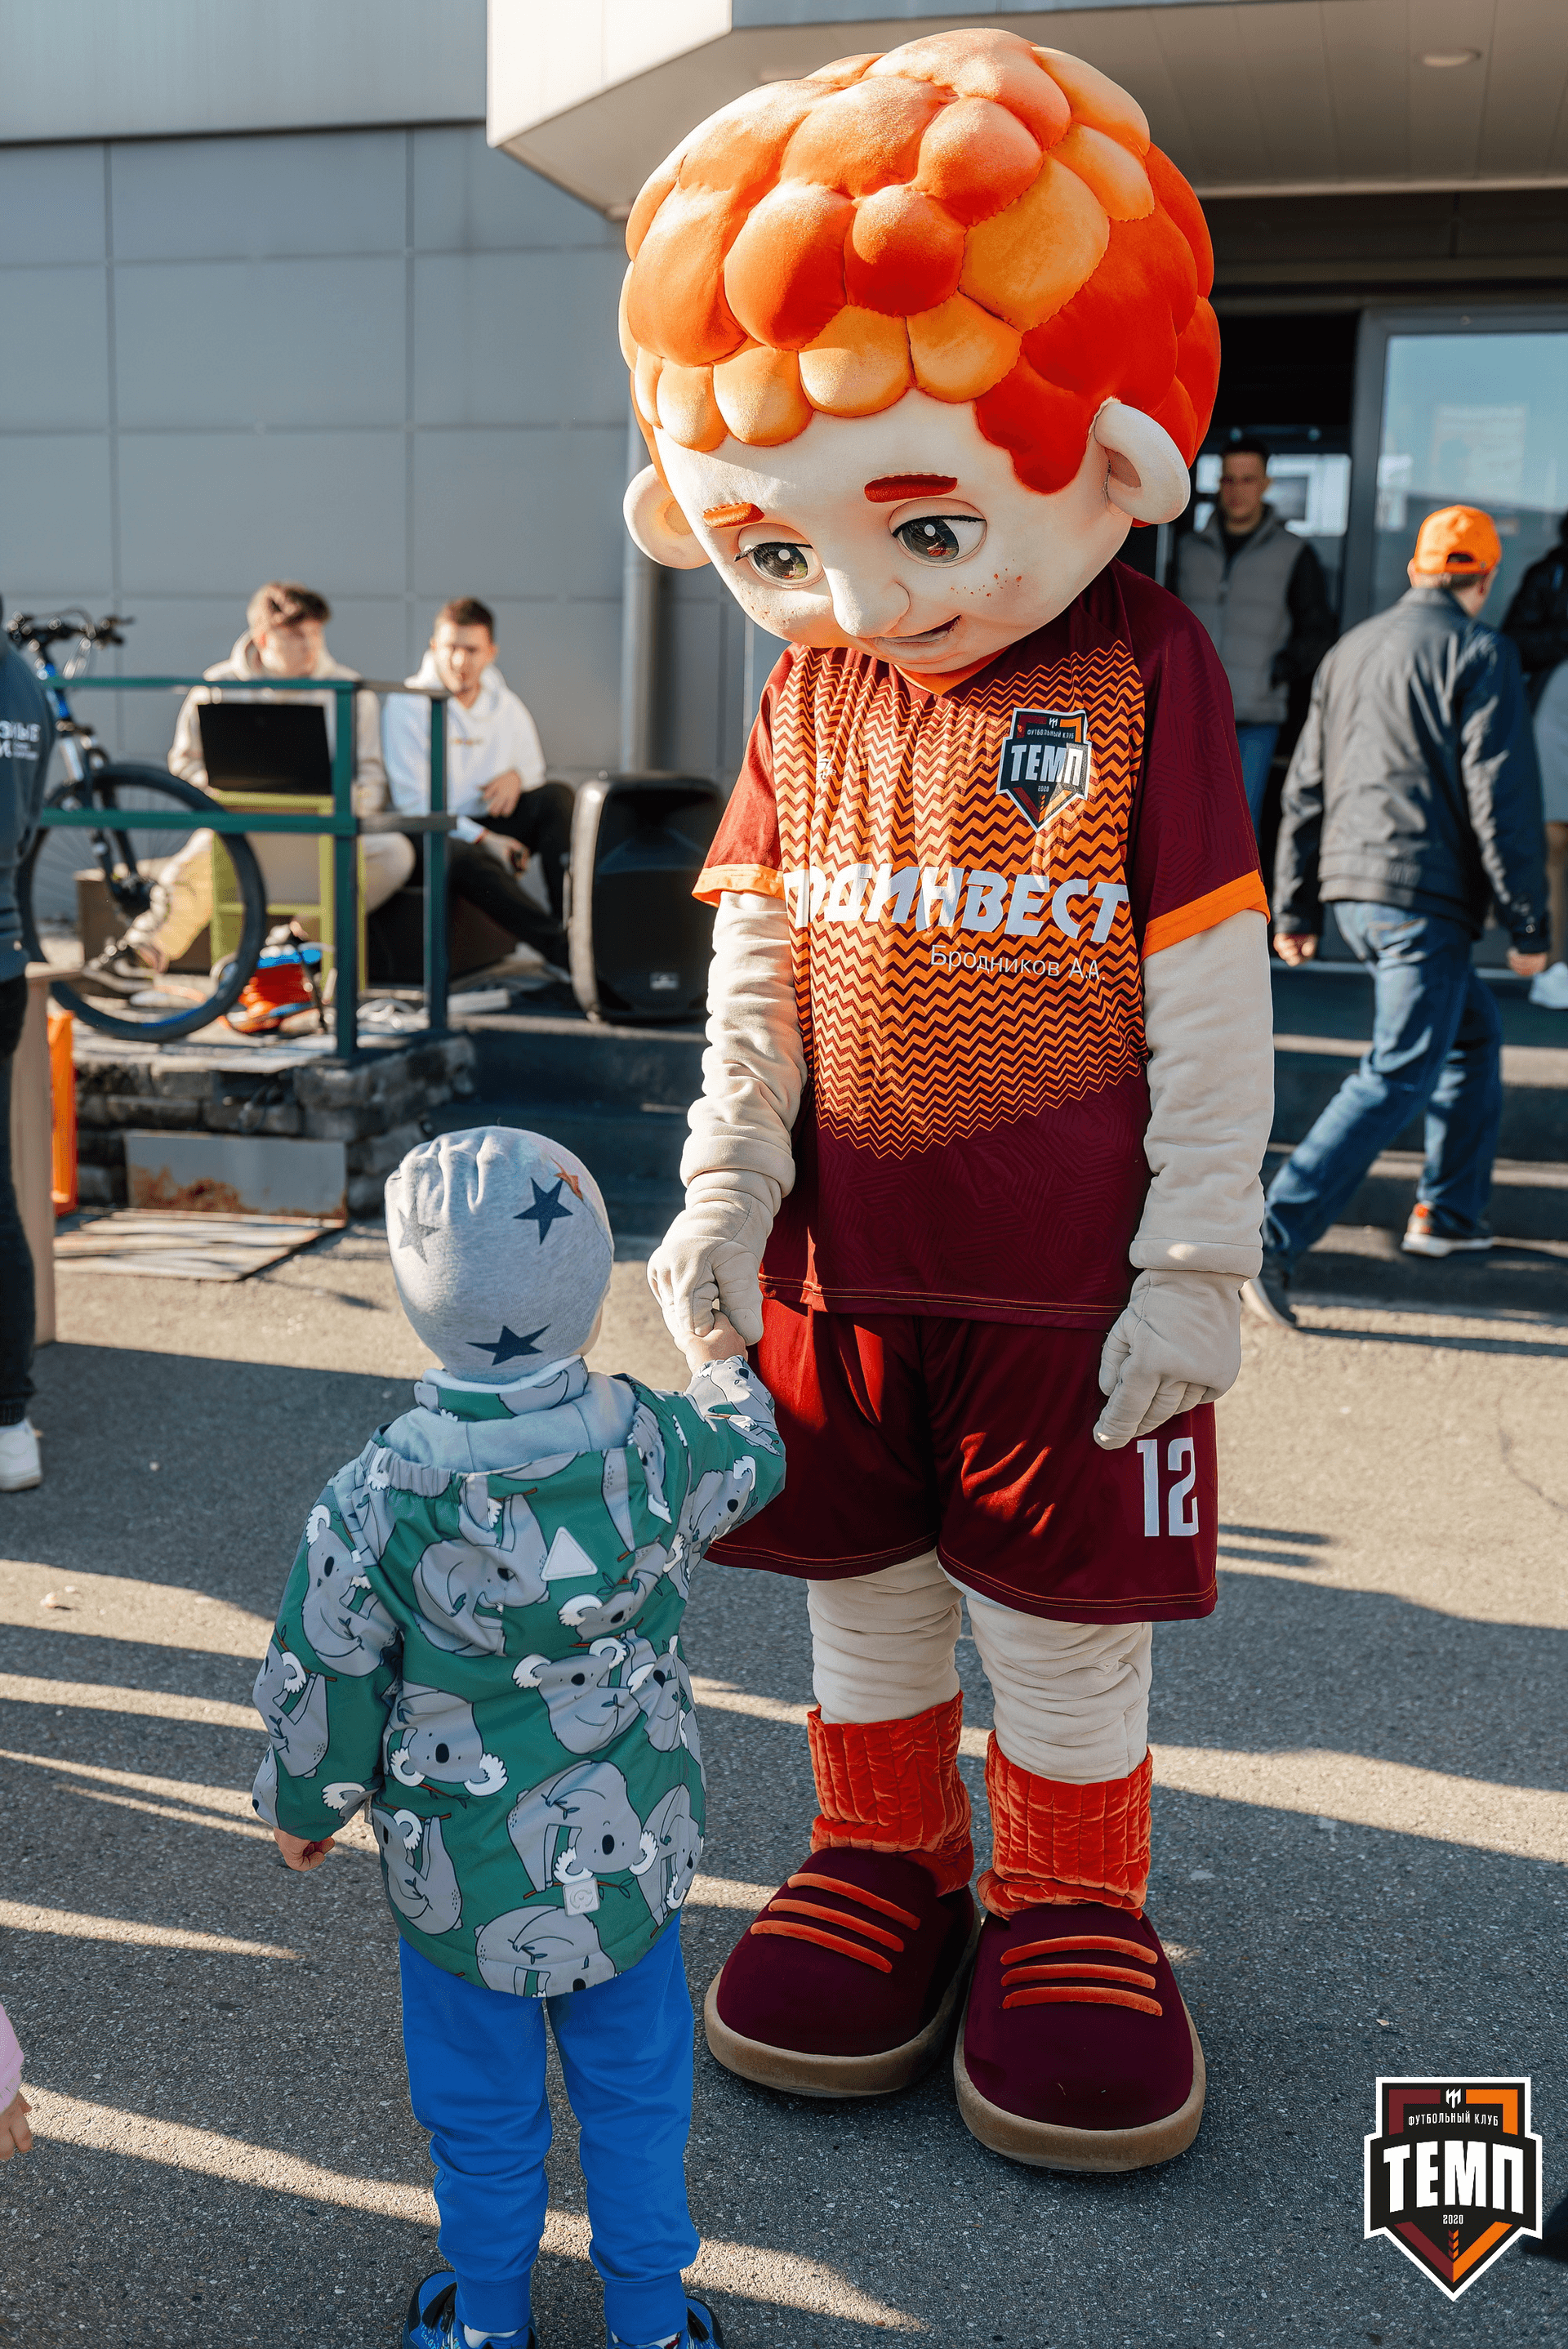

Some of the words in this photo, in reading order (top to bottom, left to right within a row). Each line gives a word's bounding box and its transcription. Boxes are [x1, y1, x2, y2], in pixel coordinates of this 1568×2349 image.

[1011, 744, 1084, 786] ТЕМП
[930, 944, 1060, 977] Бродников
[1068, 957, 1106, 980] А.А.
[1137, 1437, 1200, 1537] 12
